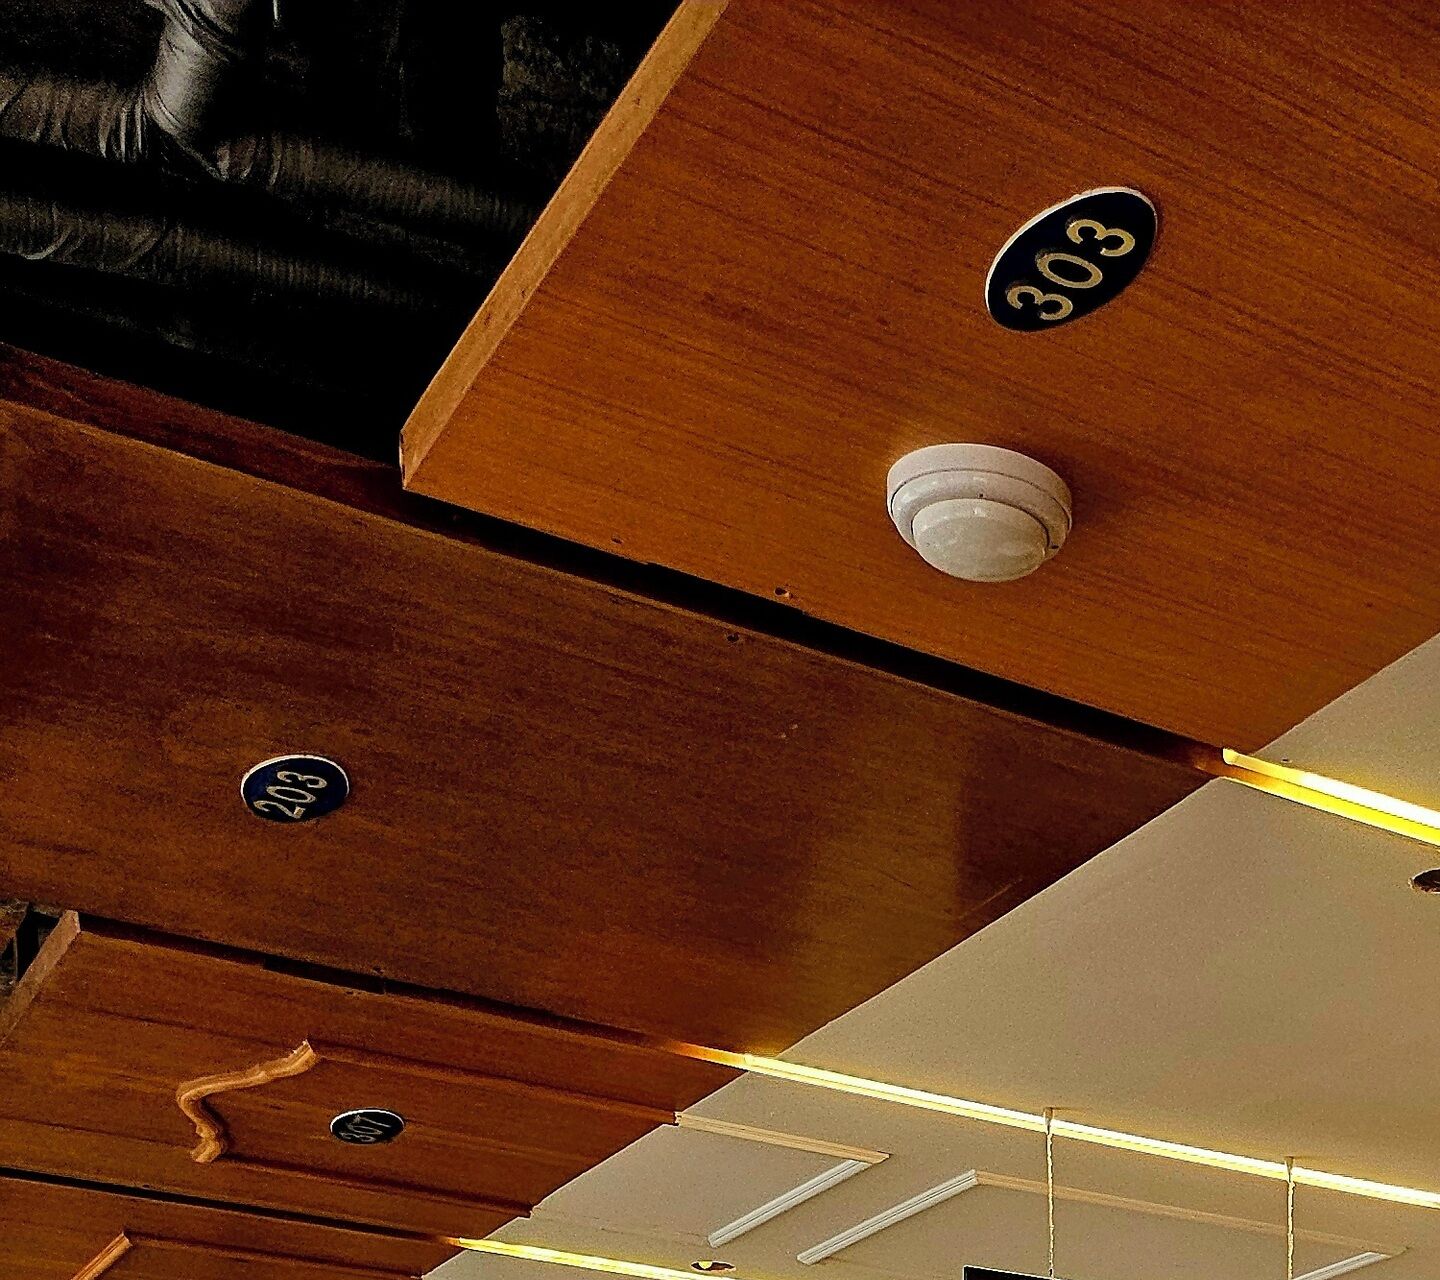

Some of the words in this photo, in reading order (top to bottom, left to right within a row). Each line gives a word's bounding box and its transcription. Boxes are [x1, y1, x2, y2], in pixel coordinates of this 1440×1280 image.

[1006, 219, 1135, 320] 303
[253, 771, 327, 818] 203
[339, 1114, 391, 1142] 307
